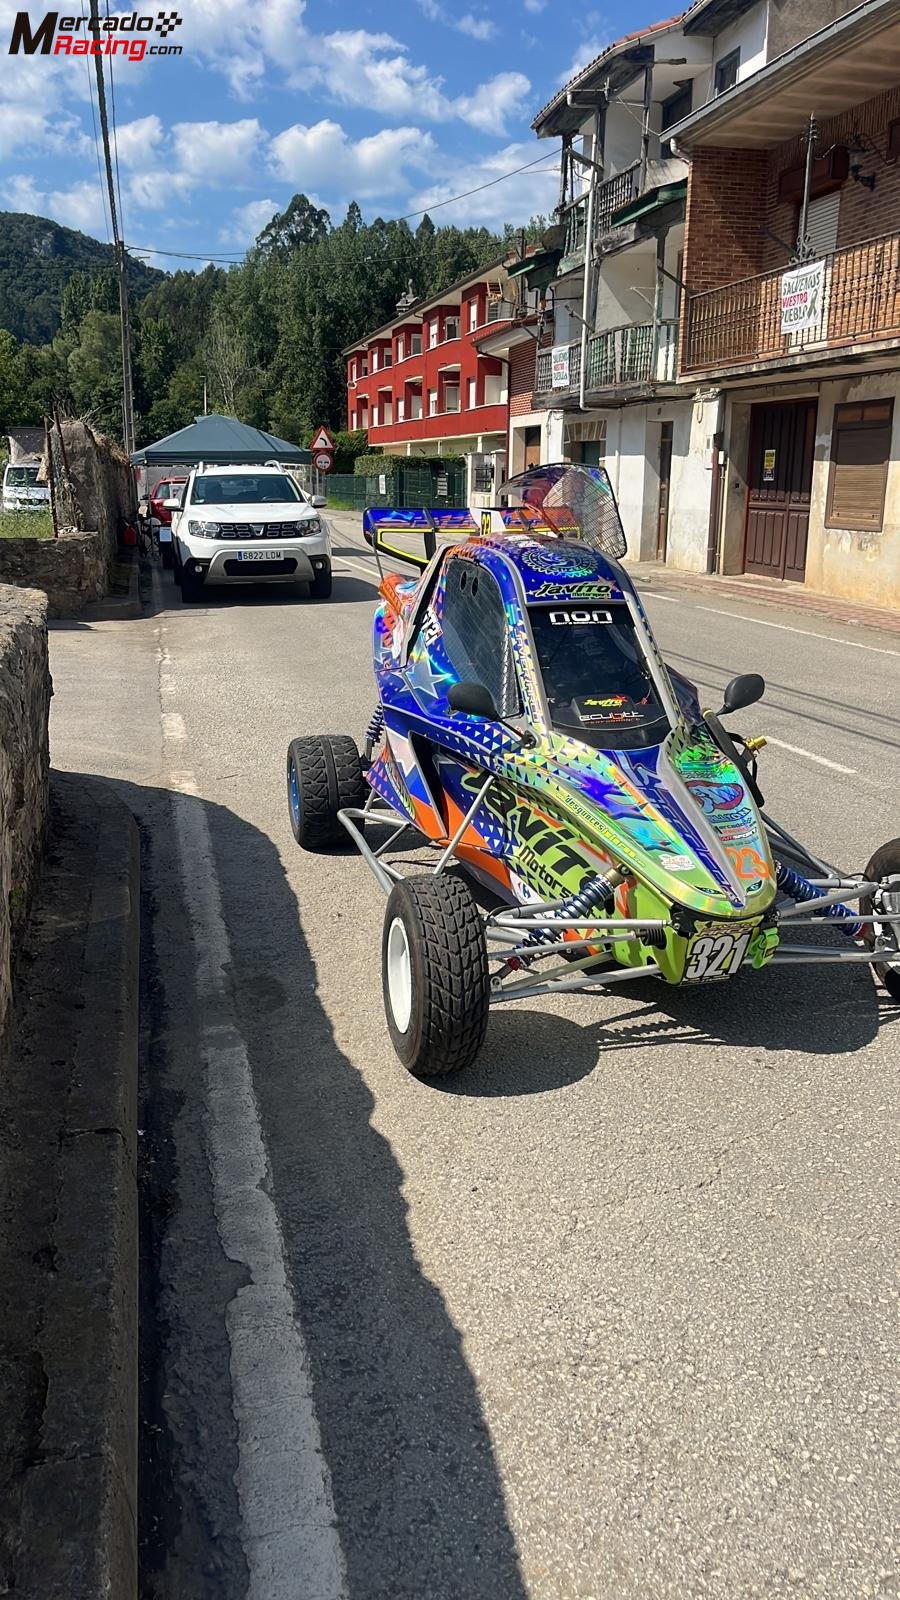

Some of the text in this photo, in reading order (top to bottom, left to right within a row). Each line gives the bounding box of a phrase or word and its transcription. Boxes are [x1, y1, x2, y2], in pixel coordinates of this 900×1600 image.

[243, 551, 264, 560] 6822
[725, 847, 769, 878] 23
[686, 934, 750, 979] 321
